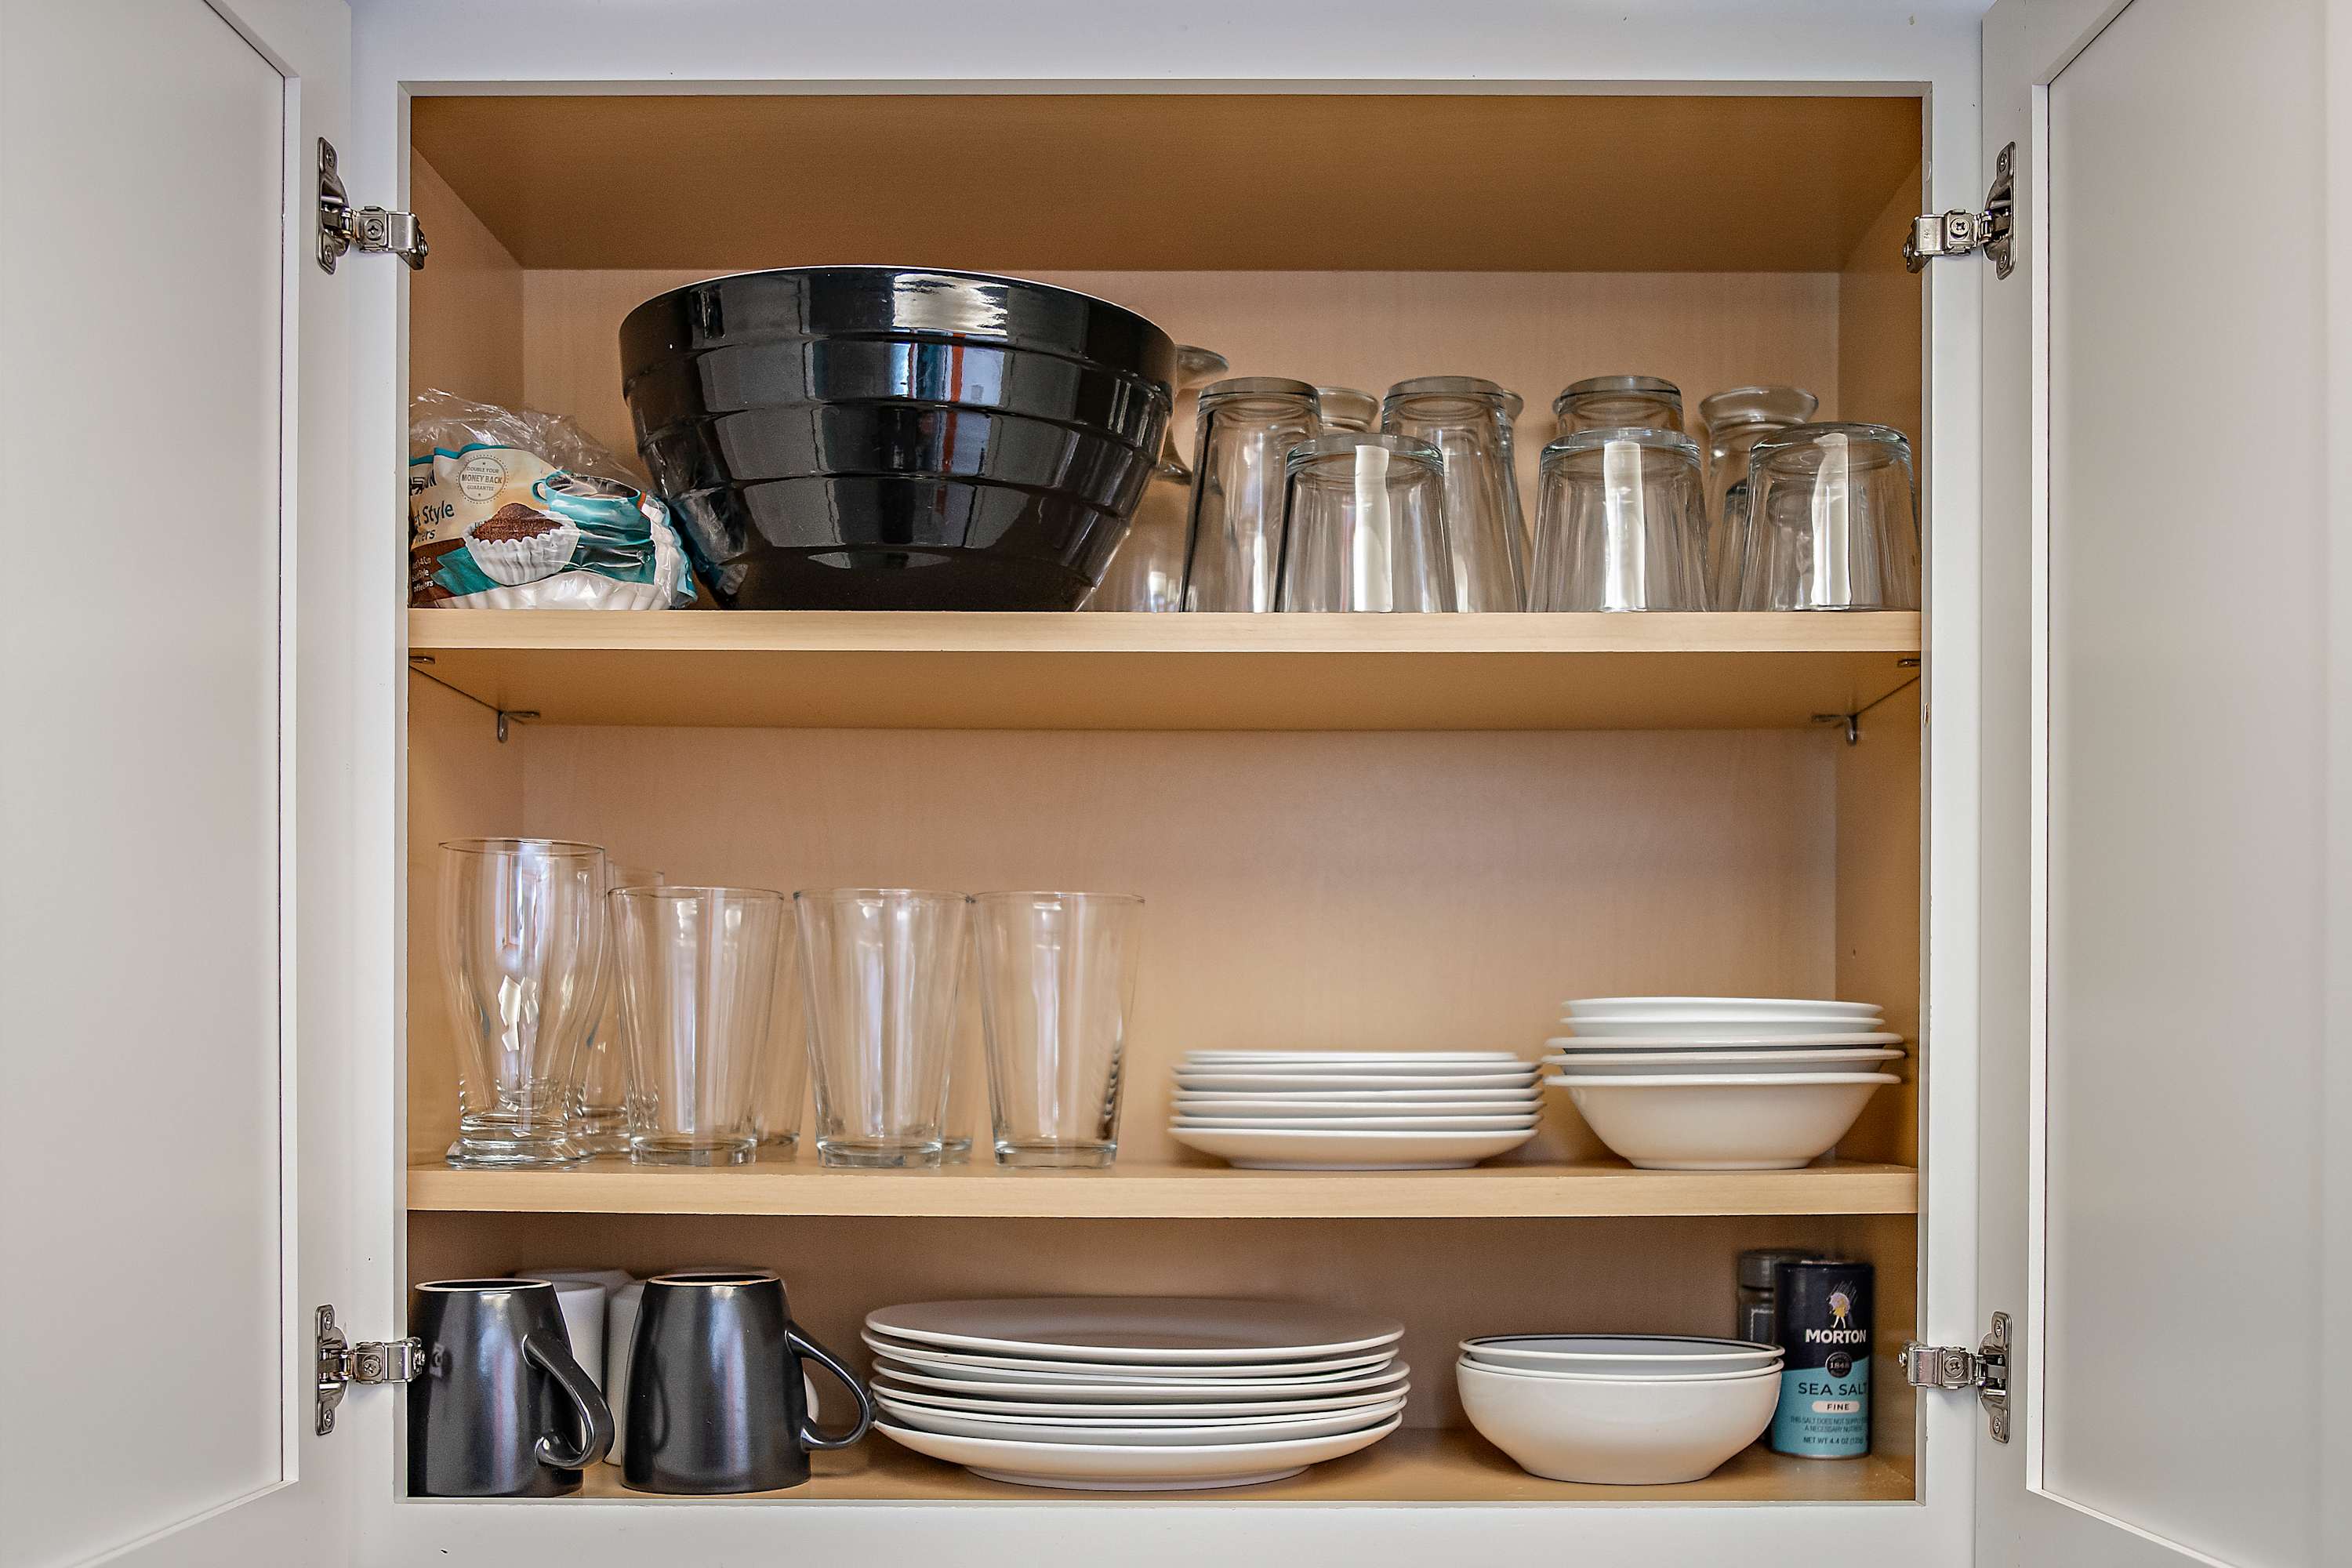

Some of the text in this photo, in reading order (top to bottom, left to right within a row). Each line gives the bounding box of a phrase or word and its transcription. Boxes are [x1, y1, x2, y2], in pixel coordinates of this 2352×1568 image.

[461, 474, 503, 484] MONEY BACK
[423, 500, 455, 525] Style
[1805, 1328, 1867, 1345] MORTON
[1798, 1382, 1867, 1396] SEA SALT
